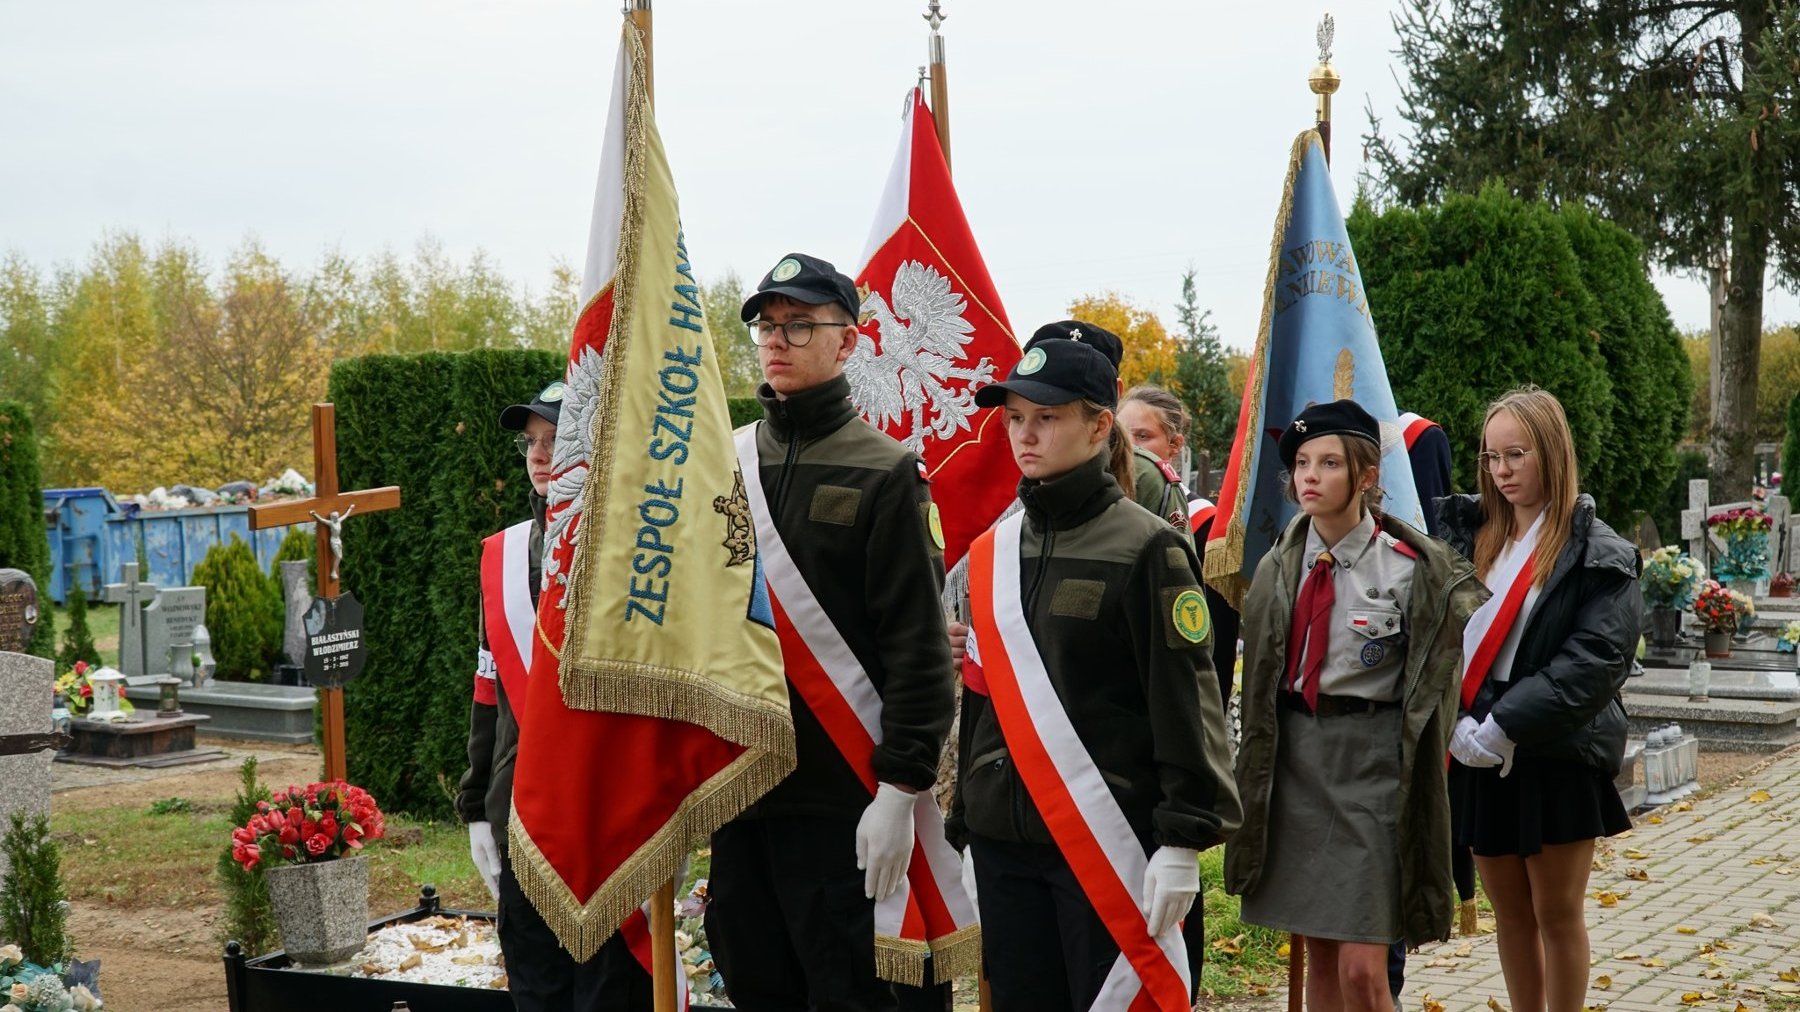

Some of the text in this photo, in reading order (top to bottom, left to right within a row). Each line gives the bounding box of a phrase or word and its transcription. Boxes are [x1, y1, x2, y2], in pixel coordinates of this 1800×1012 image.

[648, 345, 703, 466] SZKÓŁ
[624, 477, 684, 627] ZESPÓŁ
[313, 641, 358, 656] WŁODZIMIERZ
